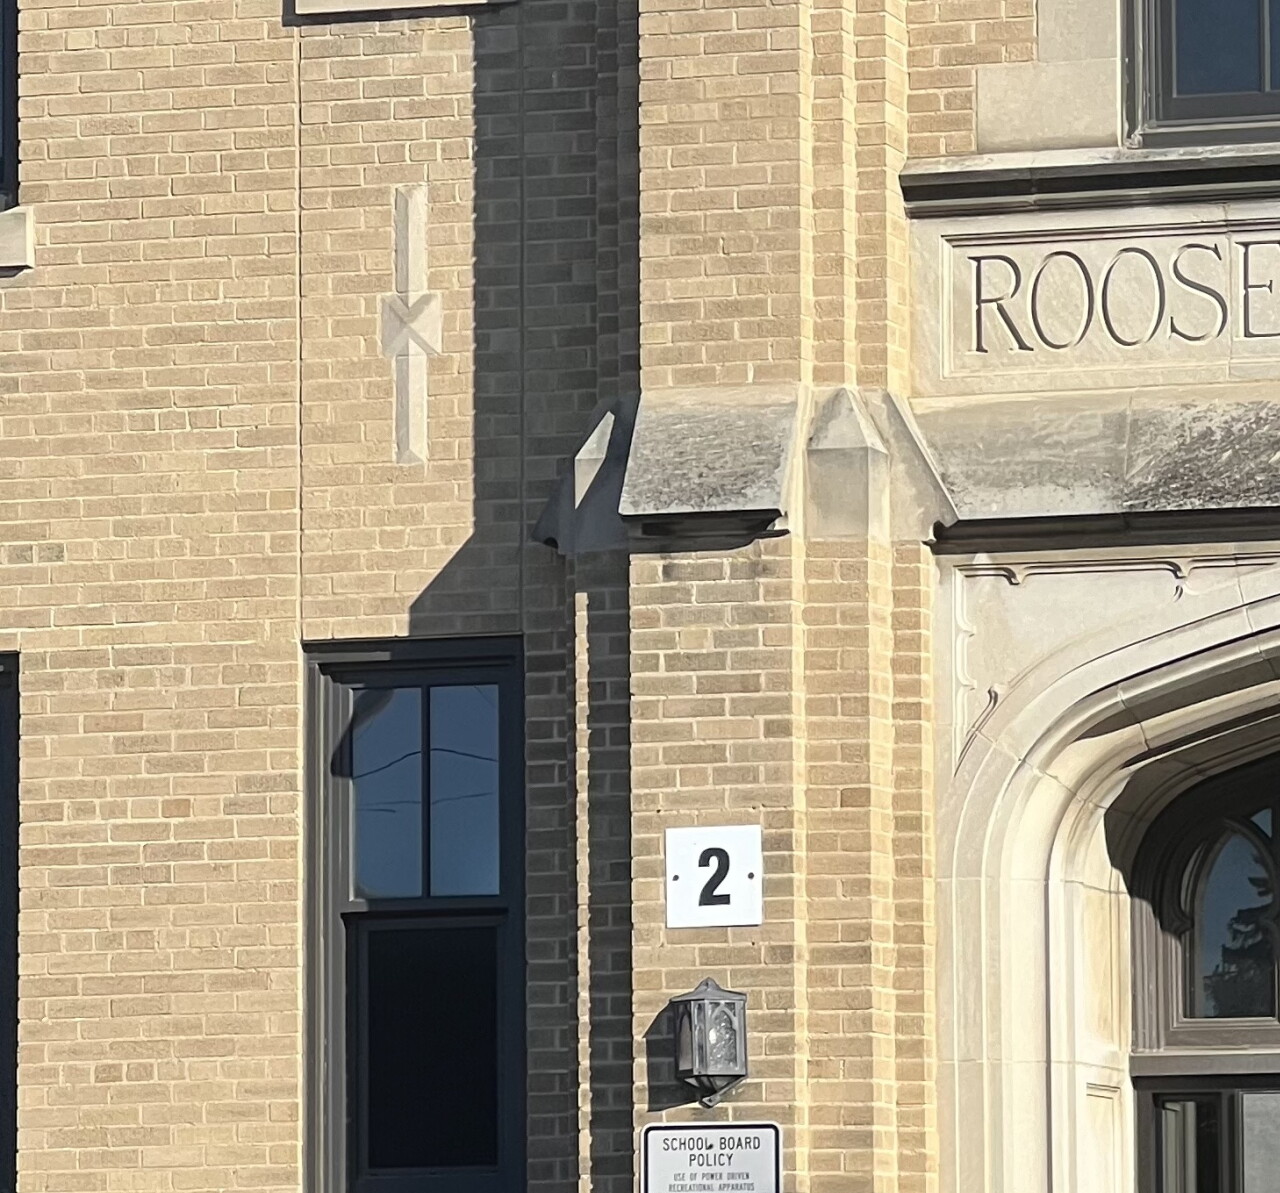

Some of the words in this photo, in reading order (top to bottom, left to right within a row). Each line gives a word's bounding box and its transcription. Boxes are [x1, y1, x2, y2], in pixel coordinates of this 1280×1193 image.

[698, 847, 731, 907] 2
[662, 1137, 712, 1151] SCHOOL
[720, 1137, 760, 1150] BOARD
[689, 1153, 734, 1167] POLICY
[674, 1173, 685, 1181] USE
[690, 1173, 697, 1181] OF
[702, 1172, 722, 1181] POWER
[727, 1172, 749, 1180] DRIVEN
[669, 1183, 714, 1192] RECREATIONAL
[718, 1183, 754, 1191] APPARATUS
